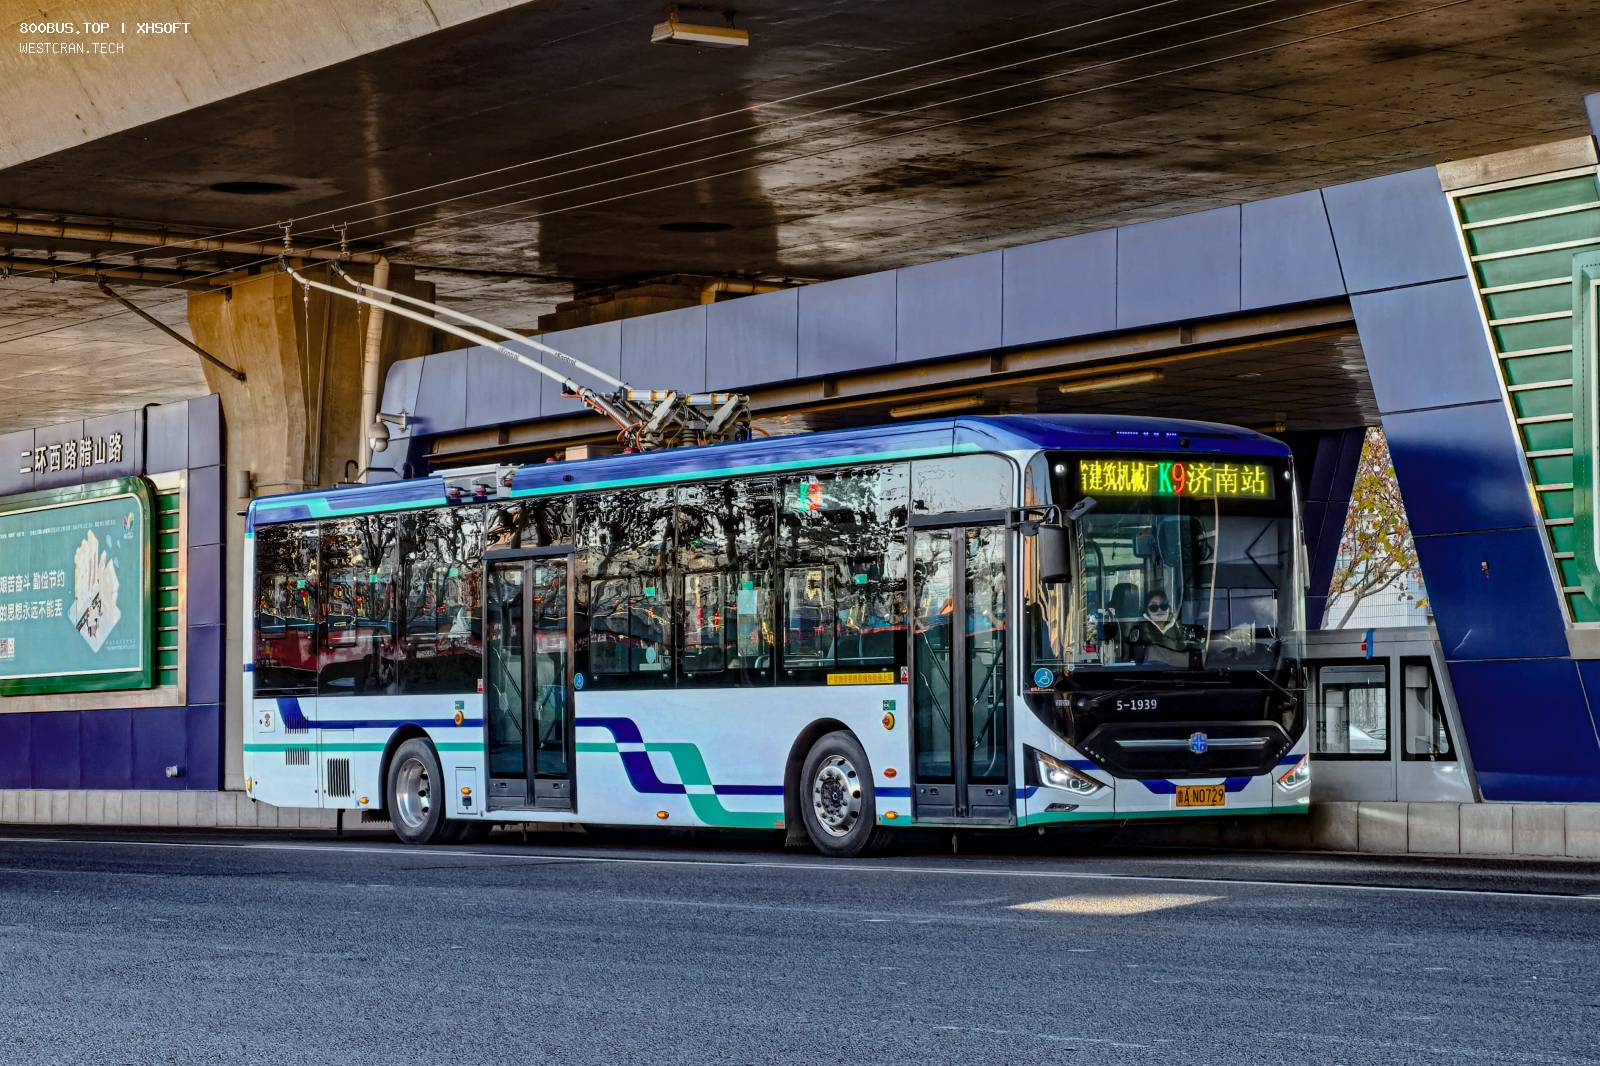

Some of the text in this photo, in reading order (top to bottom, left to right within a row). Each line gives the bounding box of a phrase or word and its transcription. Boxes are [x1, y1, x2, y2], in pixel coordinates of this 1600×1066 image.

[19, 432, 123, 474] 二环西路腊山路
[1158, 462, 1185, 496] K9
[1186, 463, 1265, 494] 济南站
[1116, 699, 1158, 711] 5-1939
